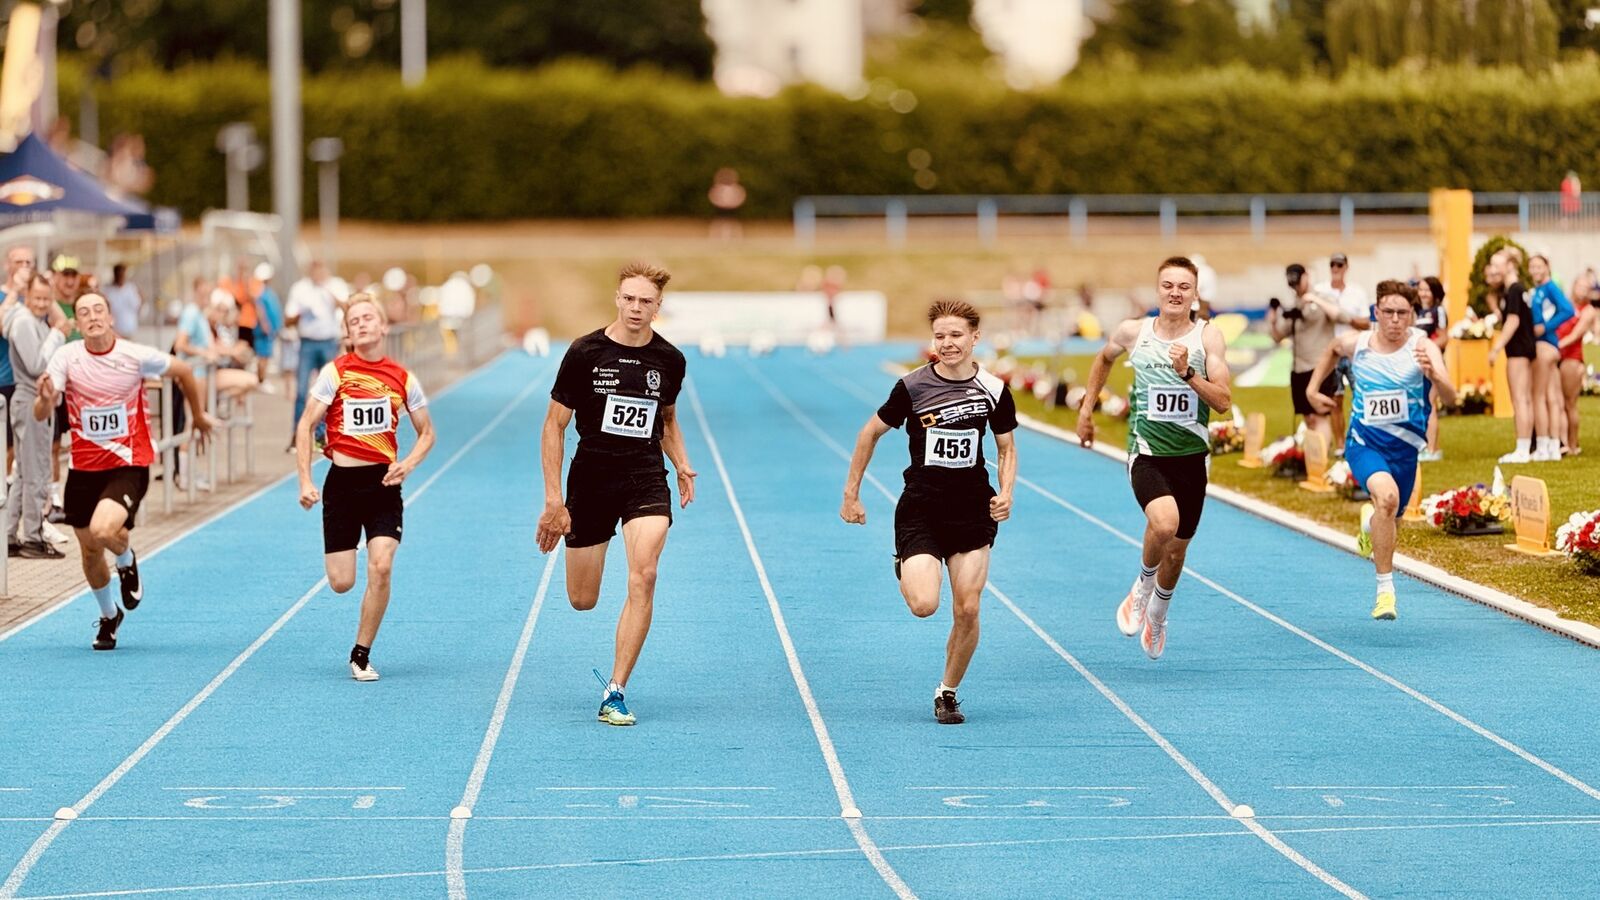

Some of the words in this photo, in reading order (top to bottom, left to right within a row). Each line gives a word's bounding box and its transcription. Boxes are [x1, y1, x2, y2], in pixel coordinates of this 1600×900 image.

[1156, 393, 1189, 412] 976
[1369, 398, 1400, 416] 280
[89, 413, 119, 431] 679
[353, 406, 384, 426] 910
[612, 404, 648, 428] 525
[933, 437, 971, 459] 453
